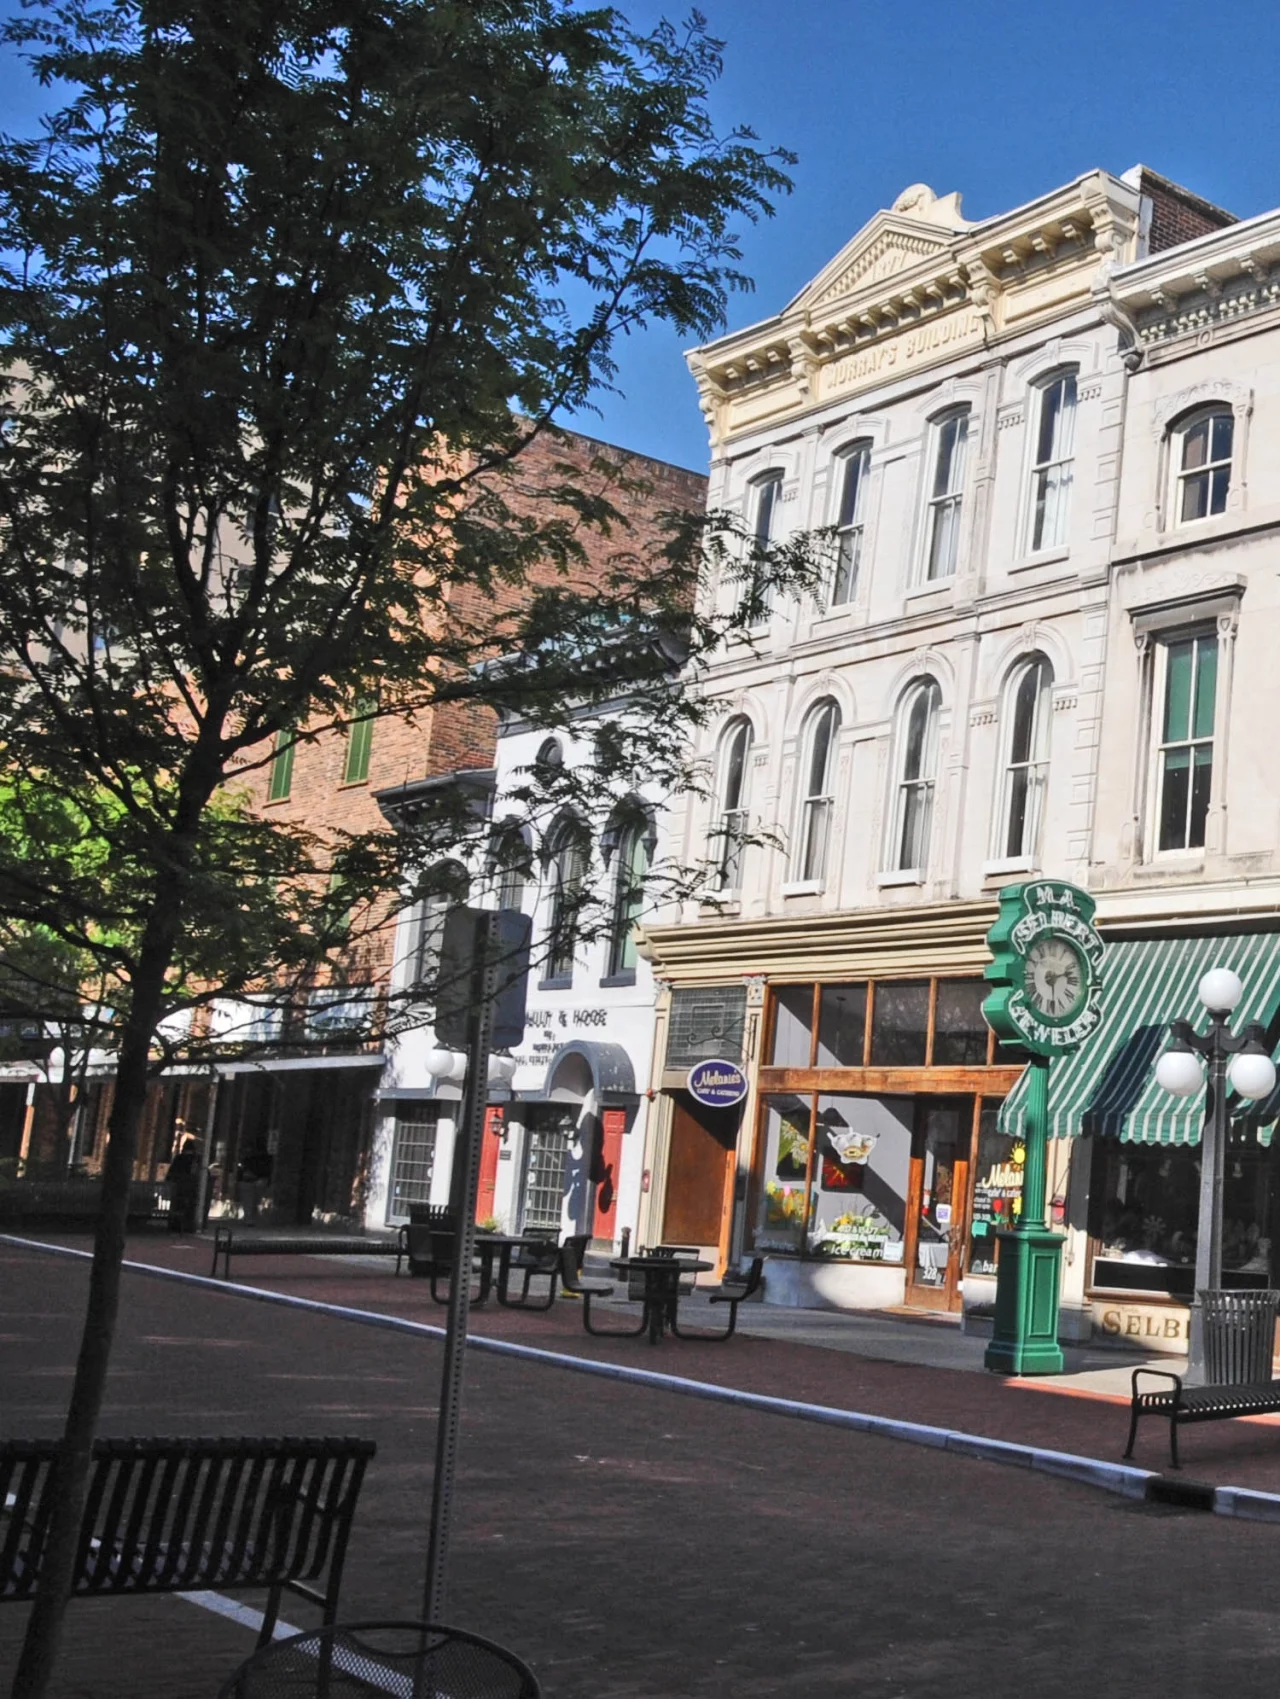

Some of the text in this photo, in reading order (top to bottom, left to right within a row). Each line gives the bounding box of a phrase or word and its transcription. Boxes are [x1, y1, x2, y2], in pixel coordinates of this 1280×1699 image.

[822, 312, 980, 390] MURRAY'S BUILDING
[1015, 910, 1100, 951] SELBERT
[694, 1068, 741, 1087] Melanie's
